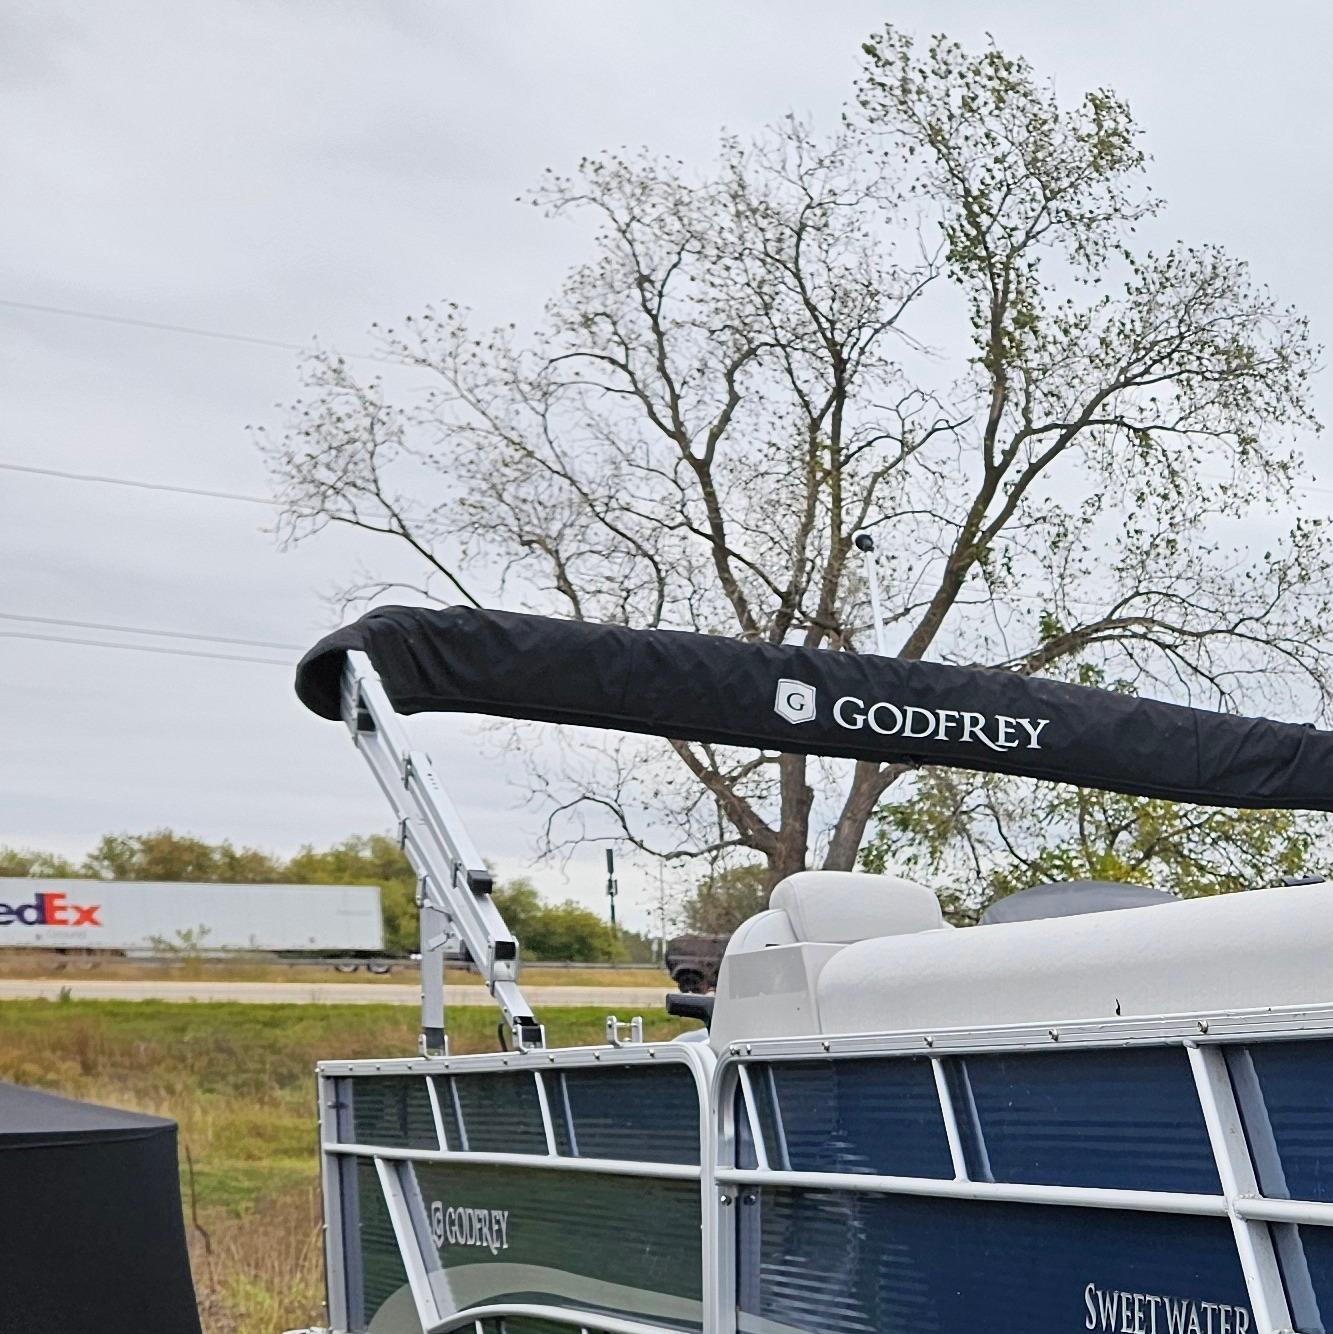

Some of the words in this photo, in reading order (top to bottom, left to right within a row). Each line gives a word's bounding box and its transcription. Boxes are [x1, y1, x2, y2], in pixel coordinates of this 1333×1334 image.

[786, 693, 805, 711] G
[832, 696, 1050, 753] GODFREY
[445, 1206, 509, 1256] GODFREY
